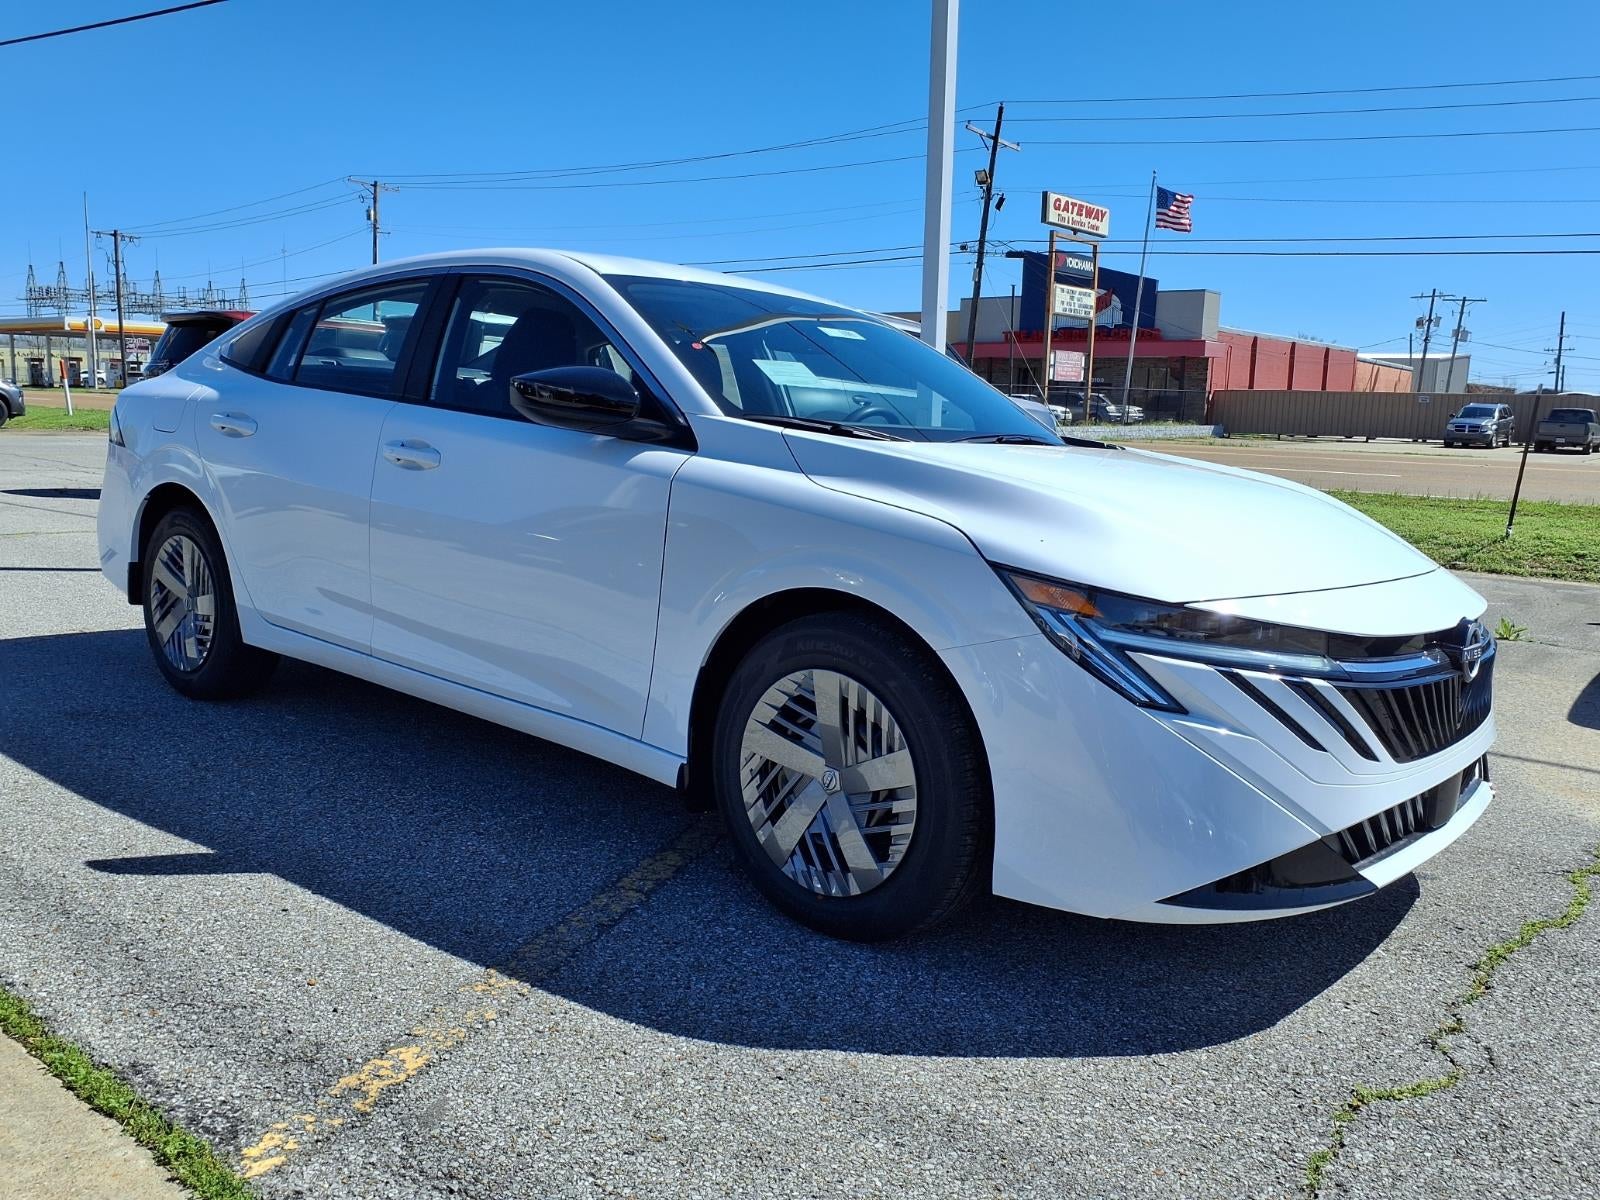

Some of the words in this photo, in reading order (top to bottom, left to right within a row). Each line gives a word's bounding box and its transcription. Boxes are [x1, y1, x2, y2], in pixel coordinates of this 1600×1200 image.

[1053, 197, 1108, 222] GATEWAY
[1057, 213, 1067, 223] Tire
[1071, 216, 1086, 228] Service
[1087, 221, 1100, 232] Center
[1065, 256, 1095, 272] YOKOHAMA
[1464, 648, 1482, 660] NISS
